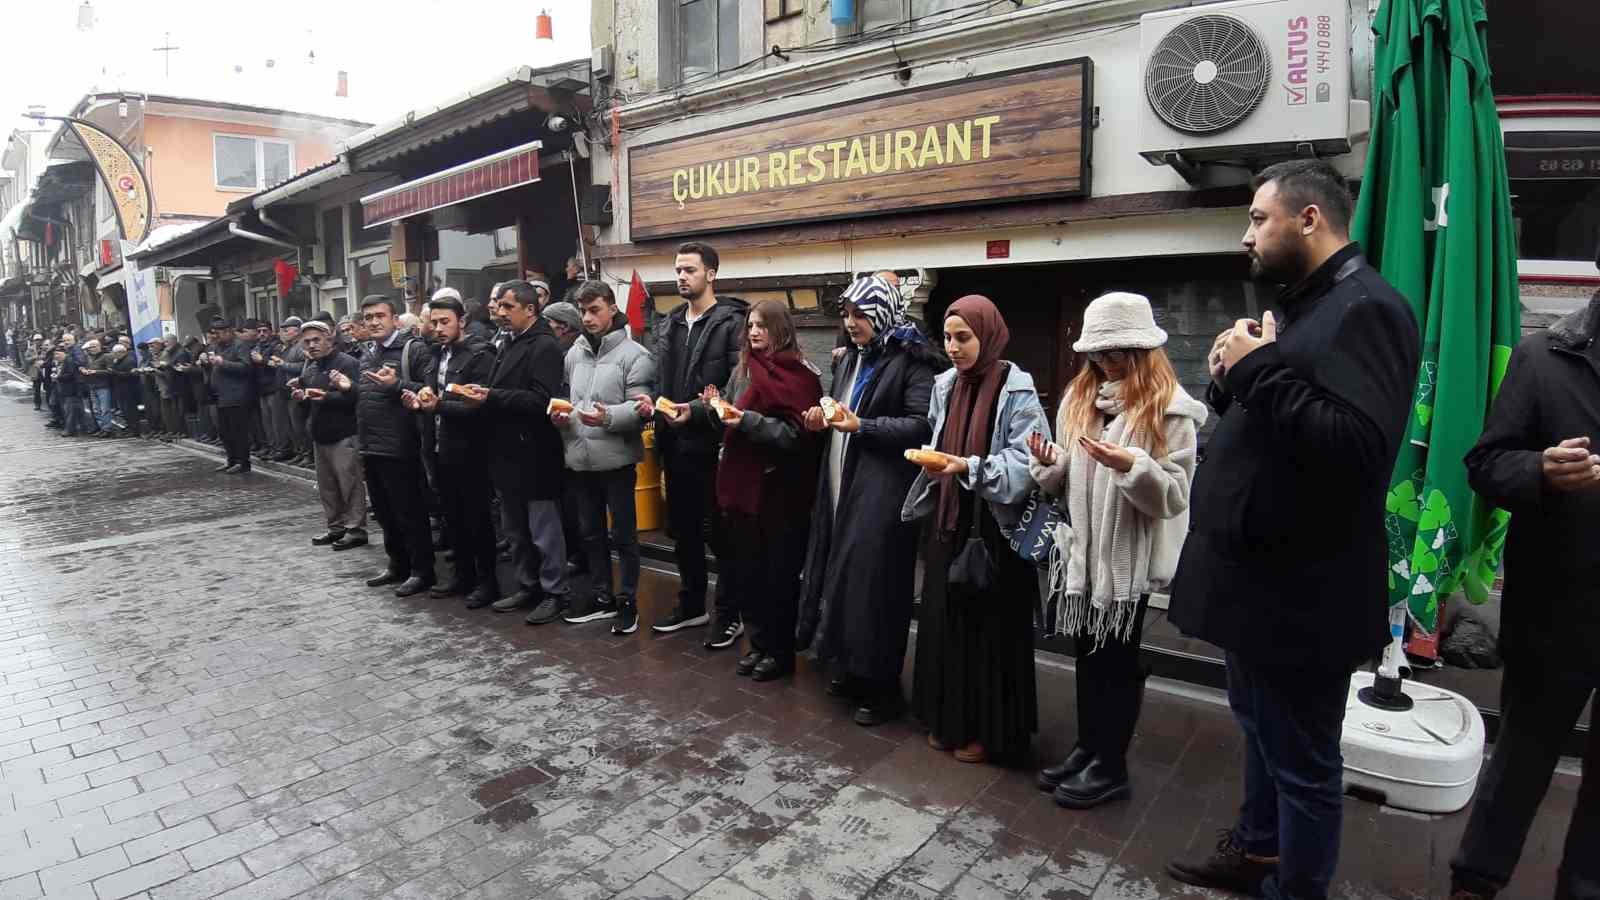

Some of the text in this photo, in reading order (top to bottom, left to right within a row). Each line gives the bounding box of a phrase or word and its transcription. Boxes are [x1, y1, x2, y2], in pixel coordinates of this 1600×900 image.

[1287, 16, 1308, 84] ALTUS
[1316, 15, 1330, 73] 444 0 888
[673, 115, 1000, 210] ÇUKUR RESTAURANT
